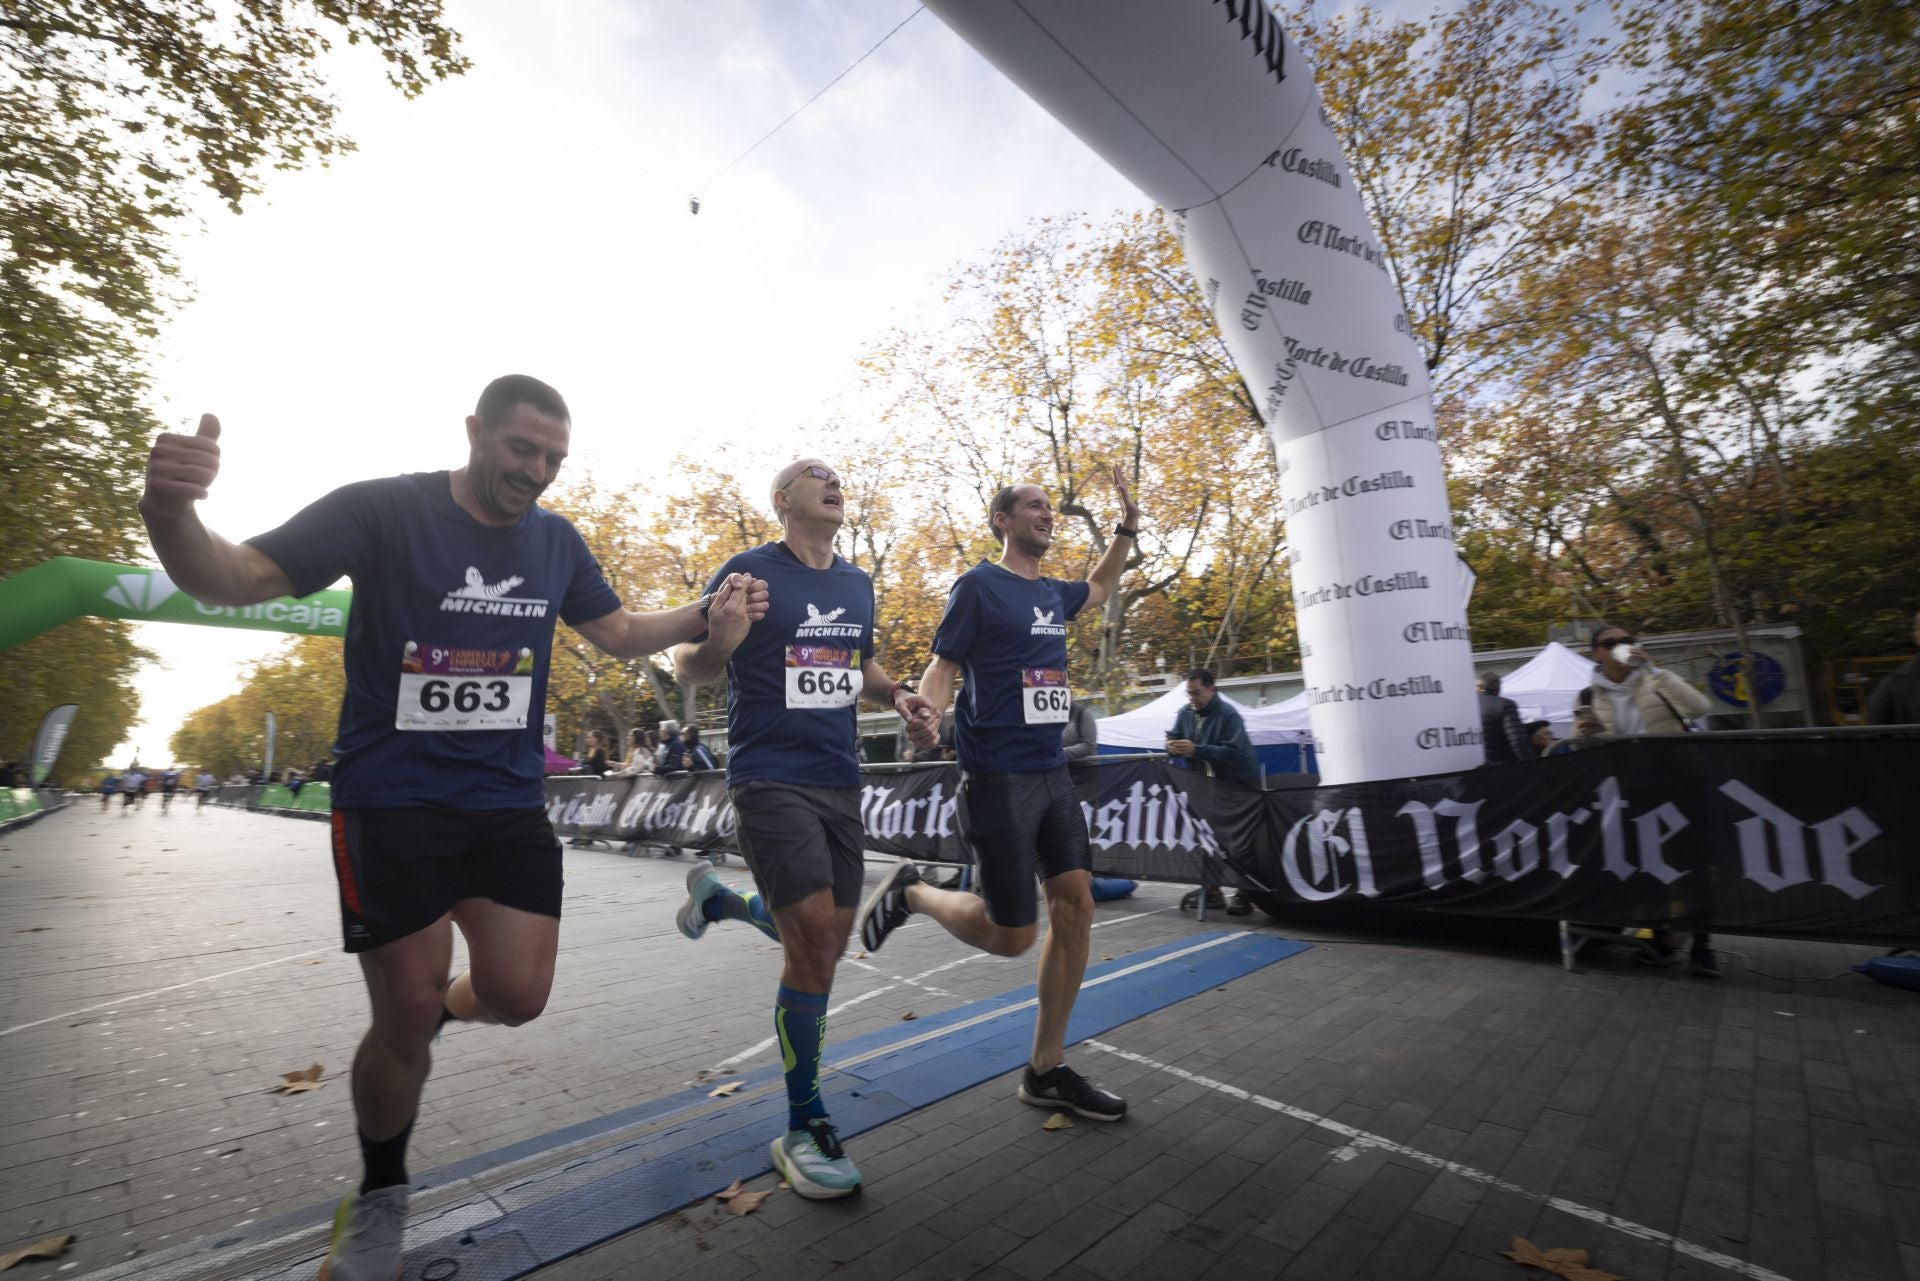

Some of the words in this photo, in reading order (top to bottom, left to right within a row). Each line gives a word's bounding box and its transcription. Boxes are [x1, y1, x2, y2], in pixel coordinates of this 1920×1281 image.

[1297, 220, 1324, 246] El
[1328, 352, 1351, 374] de
[1350, 357, 1410, 388] Castilla
[1376, 421, 1400, 441] El
[1321, 485, 1340, 502] de
[1341, 470, 1415, 497] Castilla
[1389, 519, 1414, 541] El
[1332, 583, 1353, 600] de
[1354, 570, 1430, 597] Castilla
[440, 597, 548, 618] MICHELIN
[796, 626, 862, 638] MICHELIN
[1403, 621, 1428, 643] El
[797, 670, 853, 696] 664
[1344, 683, 1366, 701] de
[1367, 674, 1443, 701] Castilla
[420, 680, 511, 713] 663
[1033, 689, 1069, 712] 662
[1416, 727, 1441, 750] El
[860, 783, 957, 841] Norte
[1281, 806, 1384, 901] El
[1394, 776, 1693, 891] Norte
[1717, 778, 1886, 900] de
